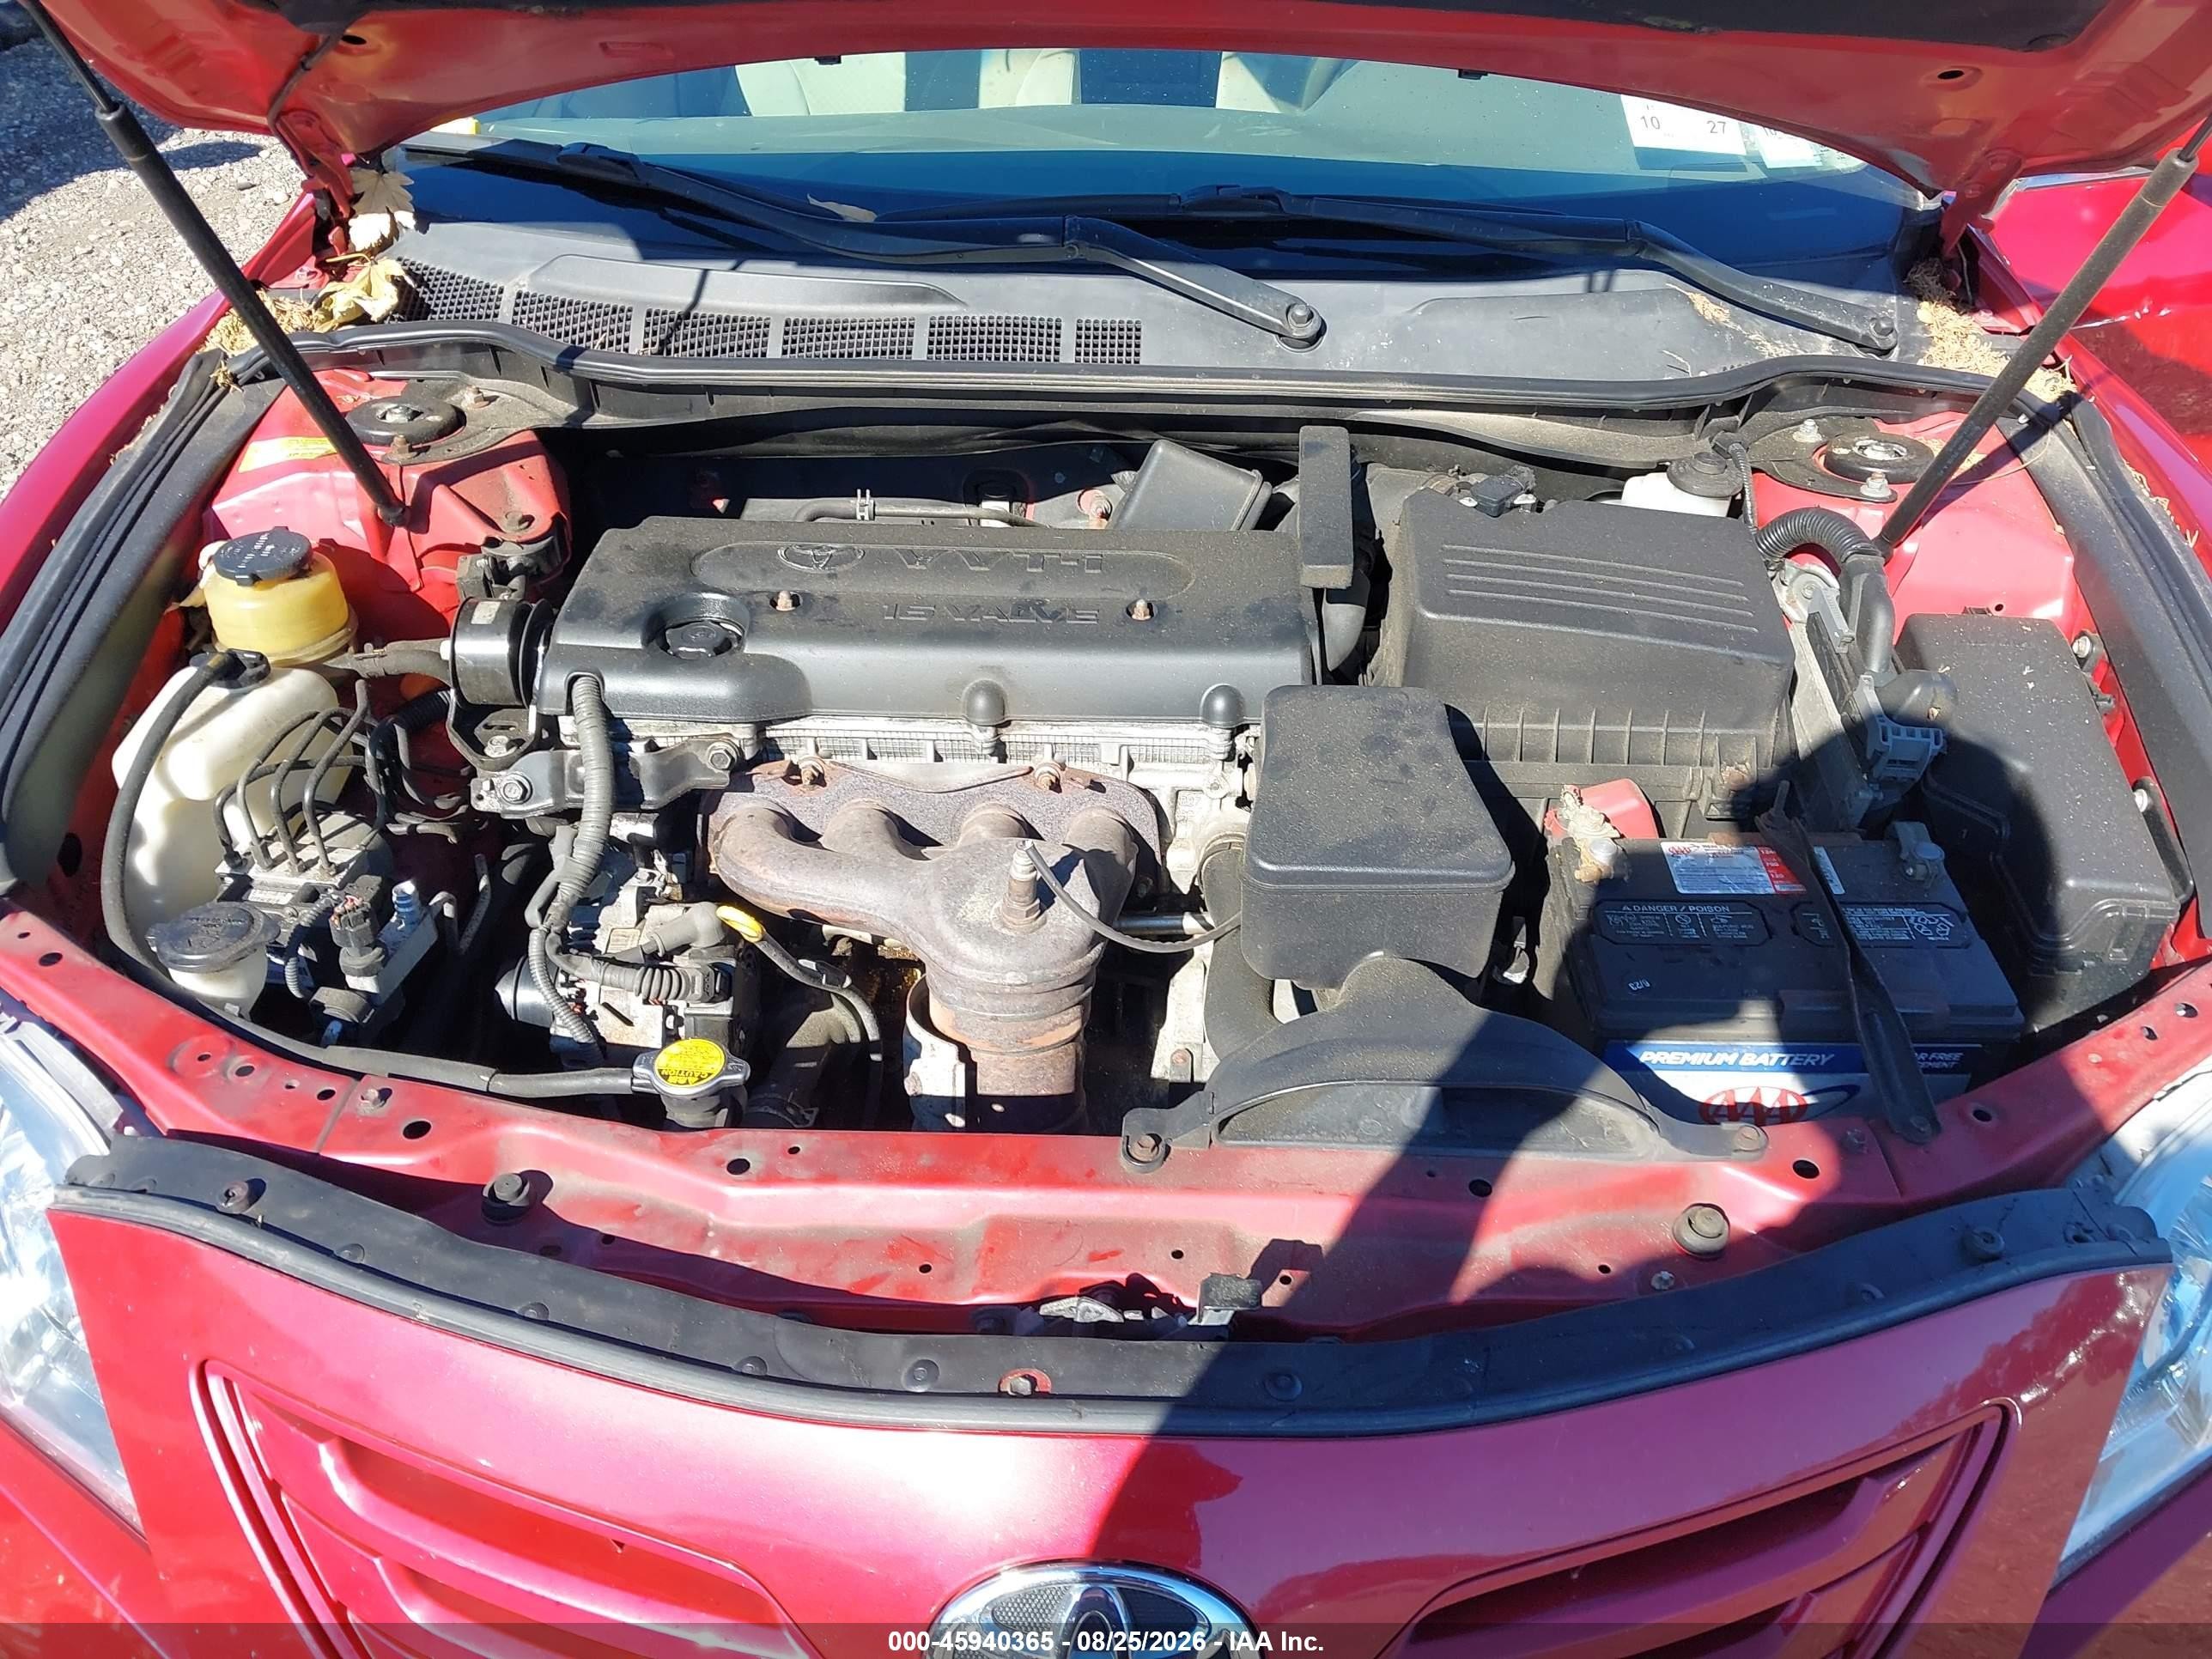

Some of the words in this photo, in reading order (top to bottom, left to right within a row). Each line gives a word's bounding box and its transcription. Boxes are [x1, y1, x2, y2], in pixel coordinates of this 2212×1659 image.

[1640, 116, 1661, 130] 10
[1707, 120, 1726, 134] 27
[1688, 905, 1731, 914] POISON
[1638, 1050, 1739, 1066] PREMIUM
[1738, 1052, 1836, 1067] BATTERY
[660, 1068, 710, 1079] CAUTION
[1698, 1085, 1808, 1127] AAA
